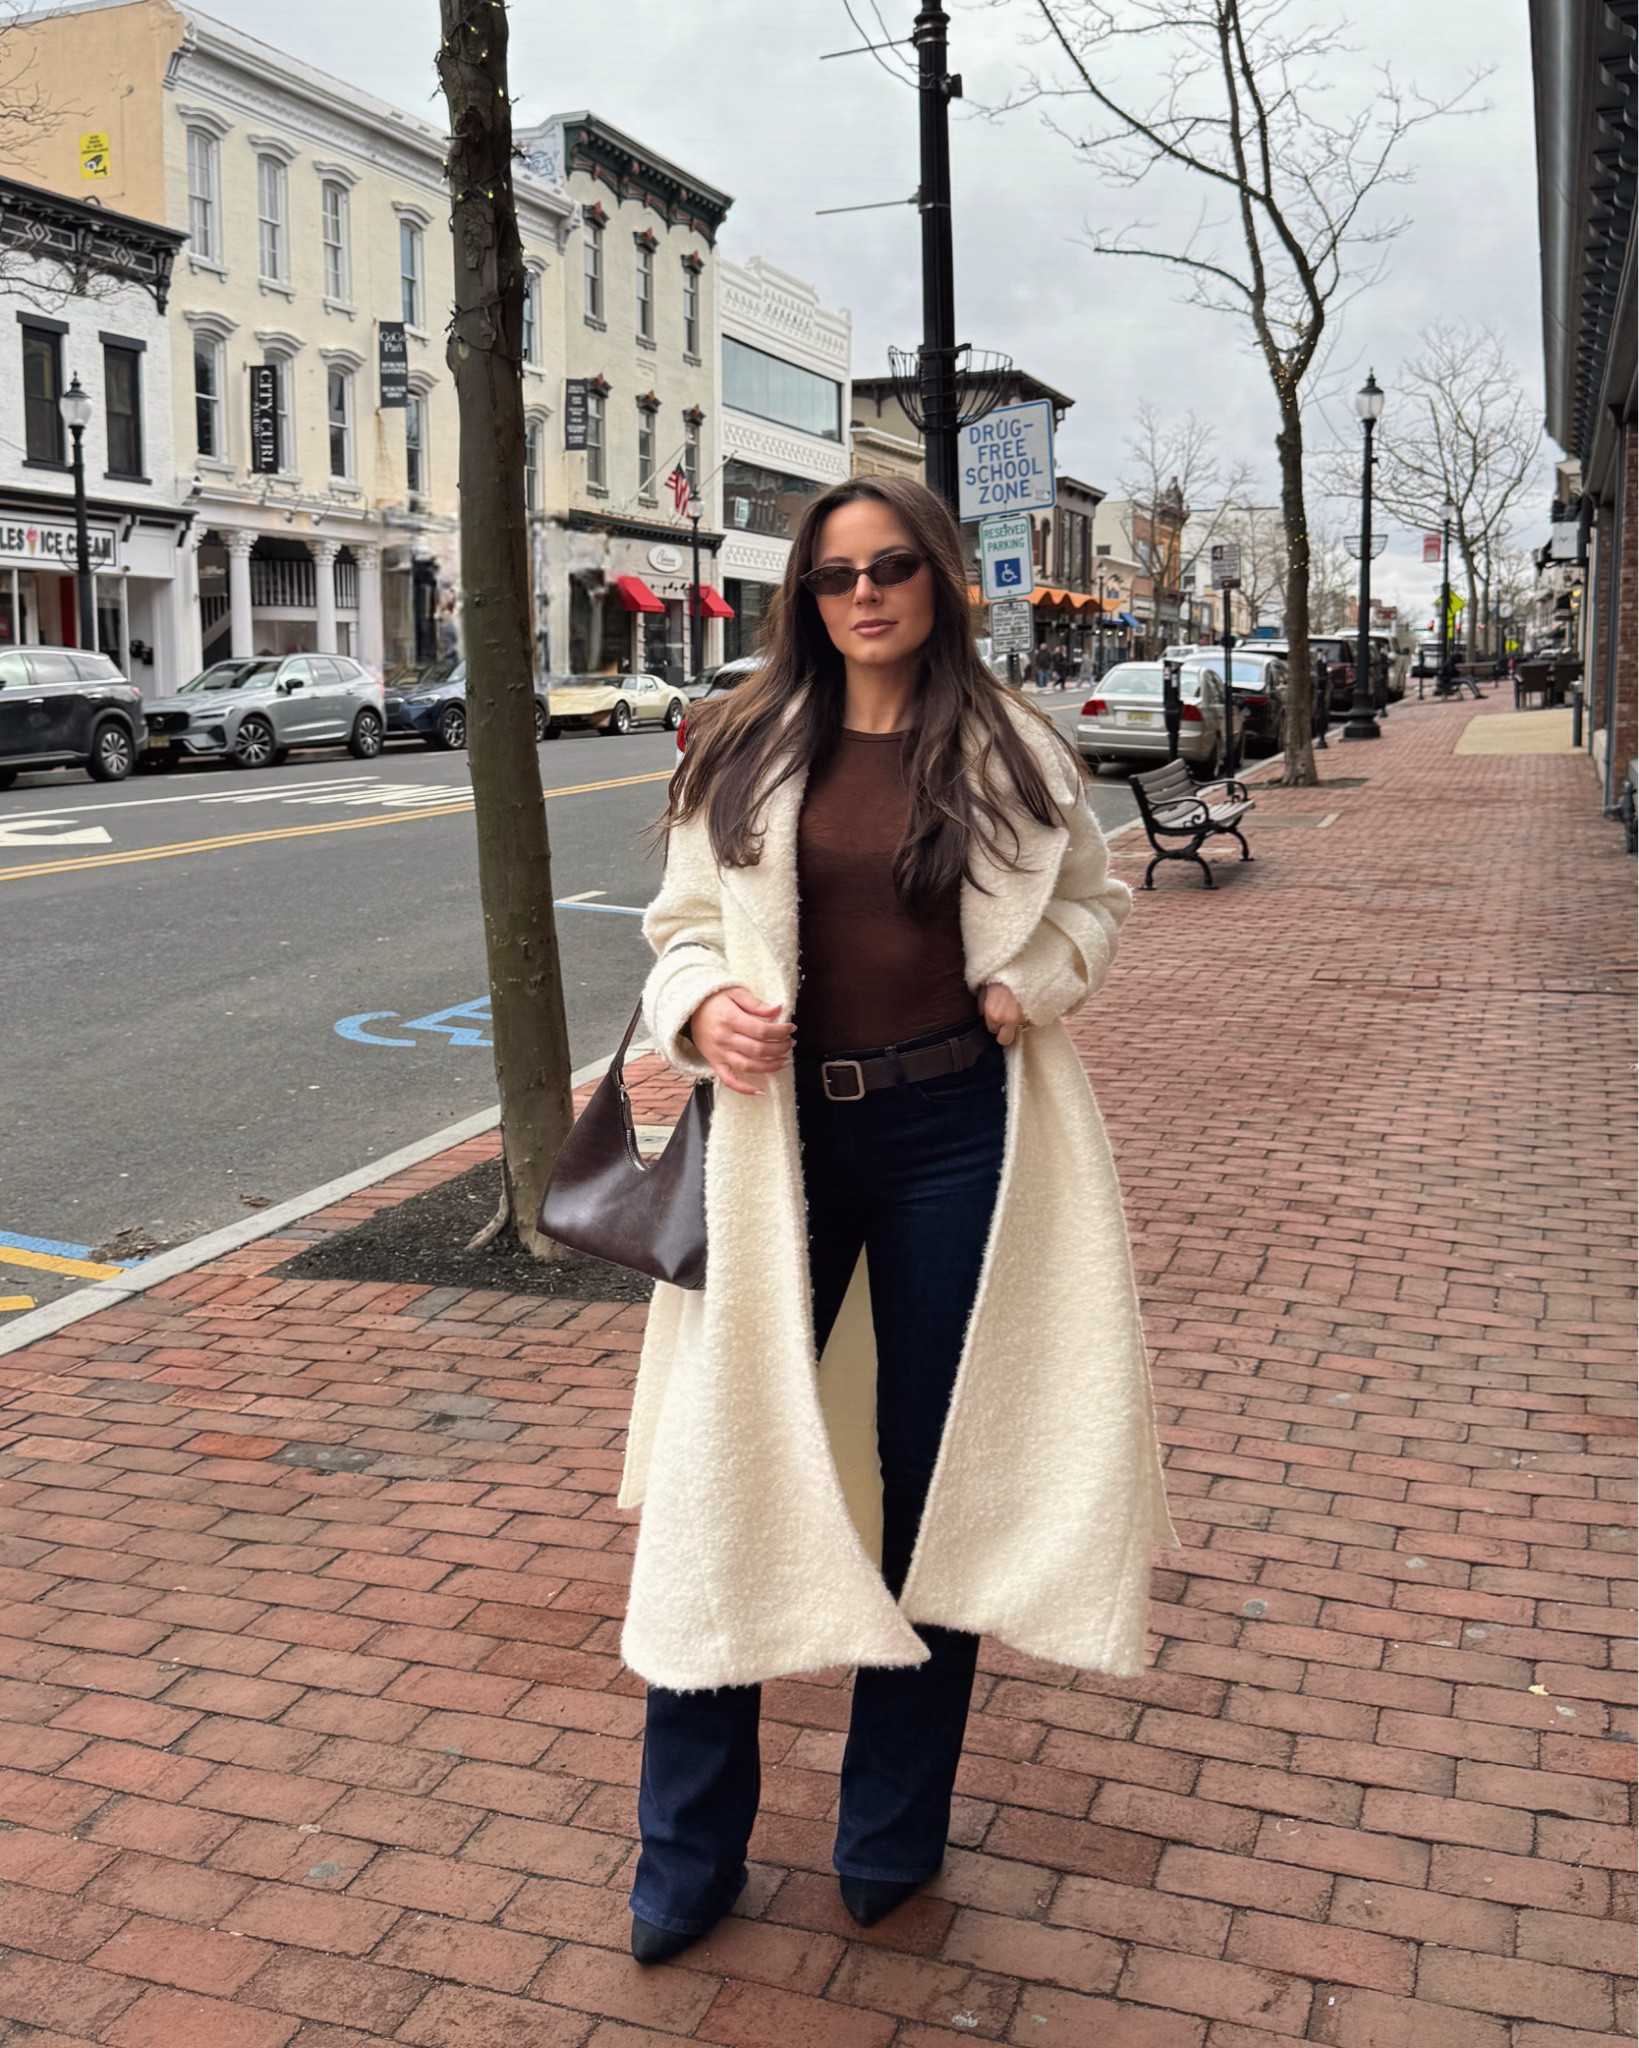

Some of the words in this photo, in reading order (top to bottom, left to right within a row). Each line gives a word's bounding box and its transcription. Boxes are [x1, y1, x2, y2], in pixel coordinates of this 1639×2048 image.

[259, 369, 273, 414] CITY
[259, 418, 274, 469] CURL
[969, 418, 1034, 445] DRUG-
[977, 438, 1027, 464] FREE
[965, 456, 1043, 486] SCHOOL
[978, 479, 1032, 505] ZONE
[41, 531, 62, 554] ICE
[983, 523, 1027, 539] RESERVED
[987, 538, 1025, 552] PARKING
